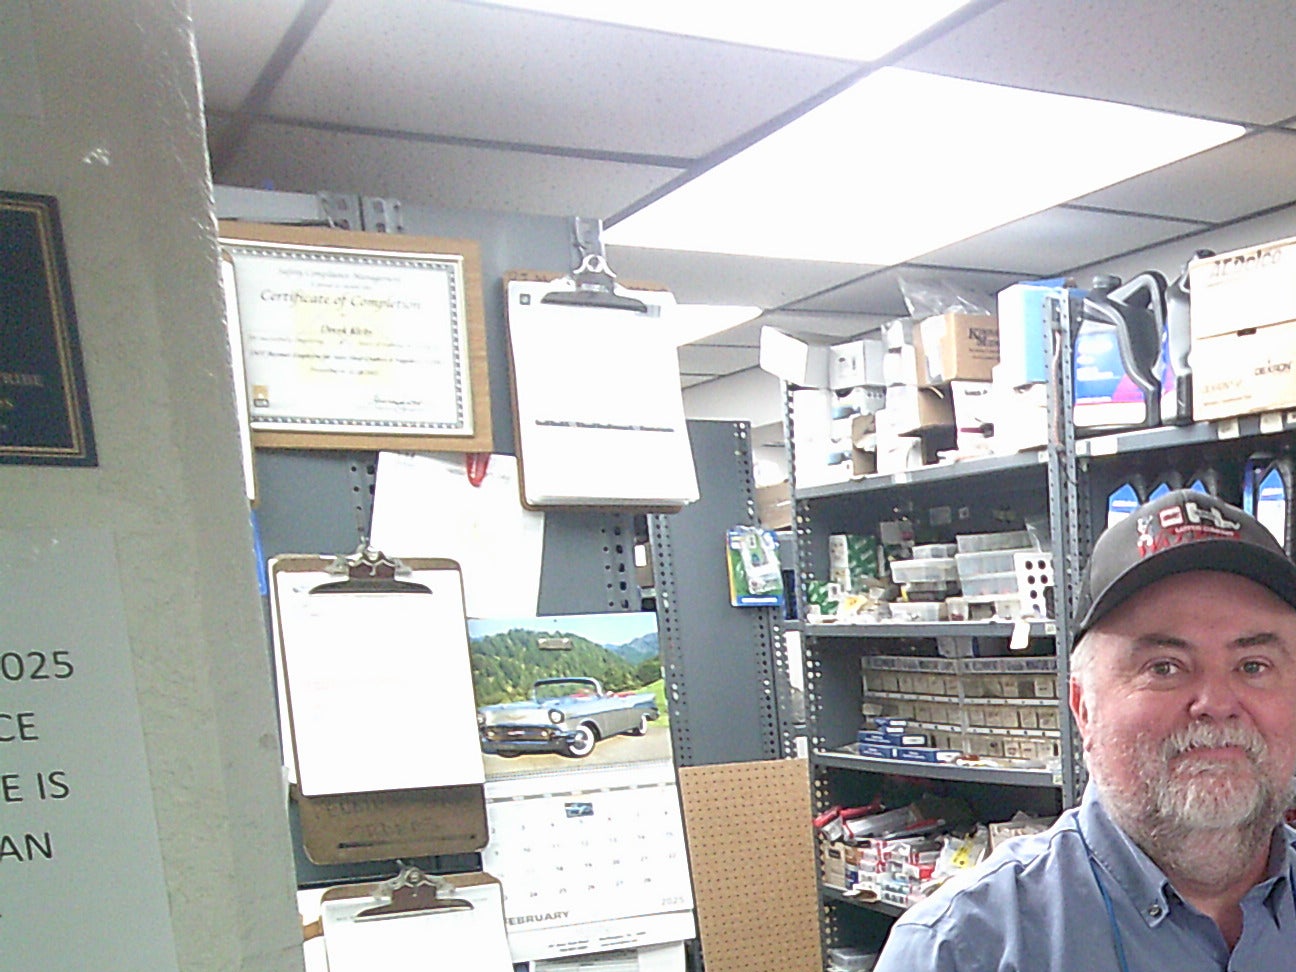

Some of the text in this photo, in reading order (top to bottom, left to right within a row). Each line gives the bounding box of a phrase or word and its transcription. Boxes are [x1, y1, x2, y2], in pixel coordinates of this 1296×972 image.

[260, 289, 421, 312] Certificate of Completion
[37, 771, 70, 800] IS
[506, 911, 570, 926] EBRUARY
